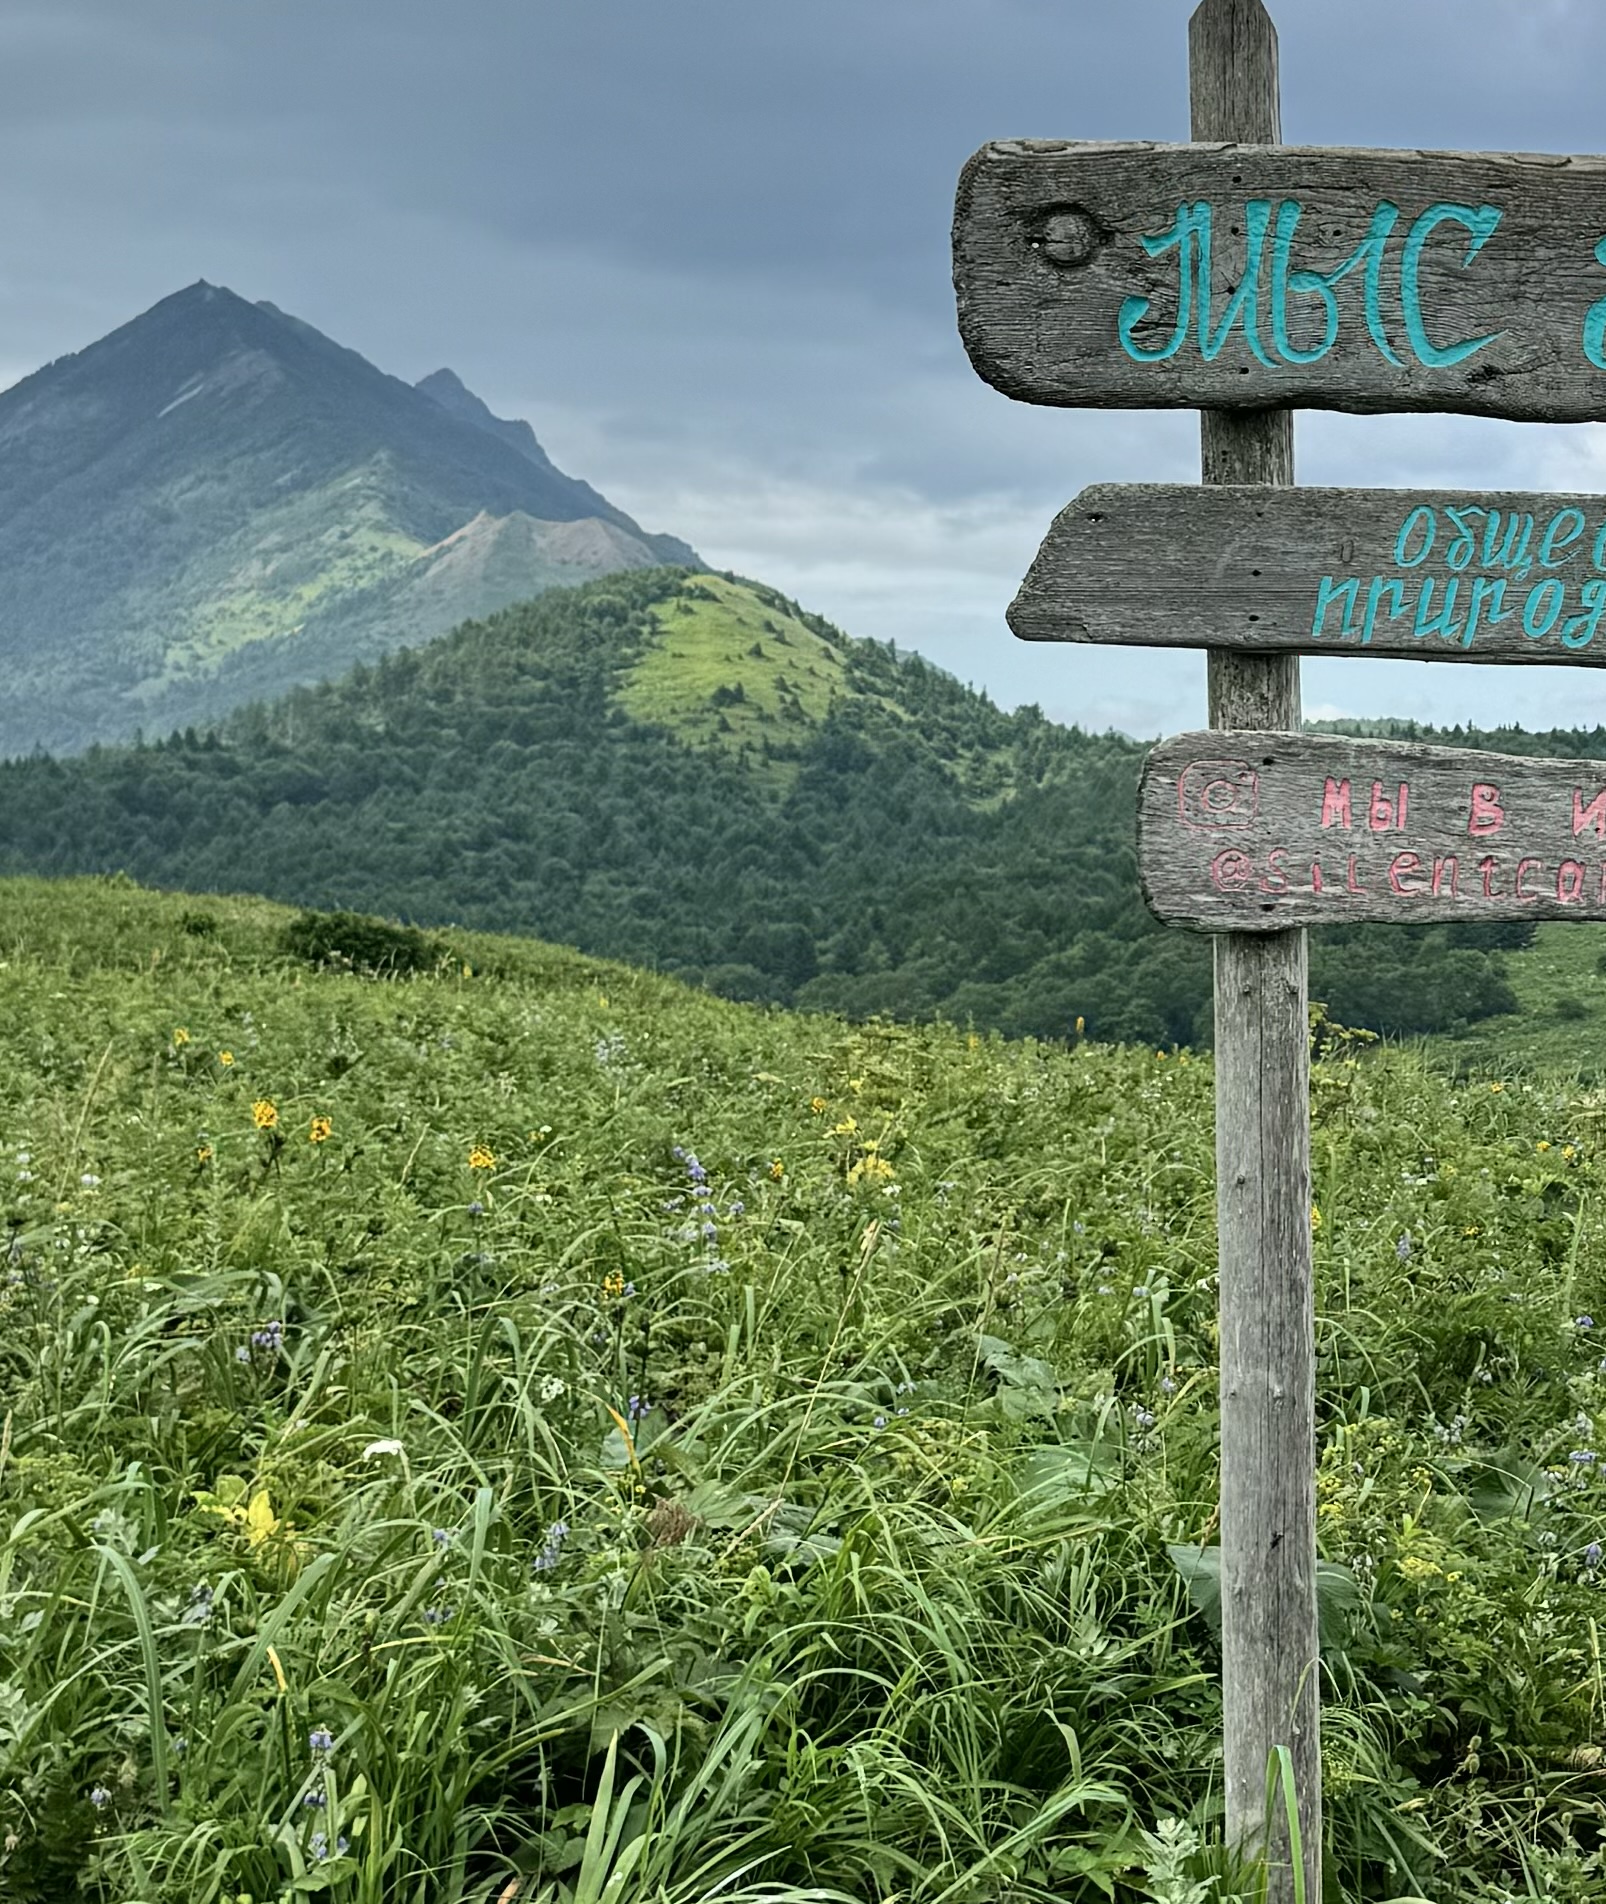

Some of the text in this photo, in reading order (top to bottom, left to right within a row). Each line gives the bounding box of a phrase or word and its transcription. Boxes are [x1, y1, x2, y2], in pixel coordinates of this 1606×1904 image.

[1117, 197, 1507, 369] МЫС
[1320, 775, 1408, 831] МЫ
[1468, 782, 1505, 837] В
